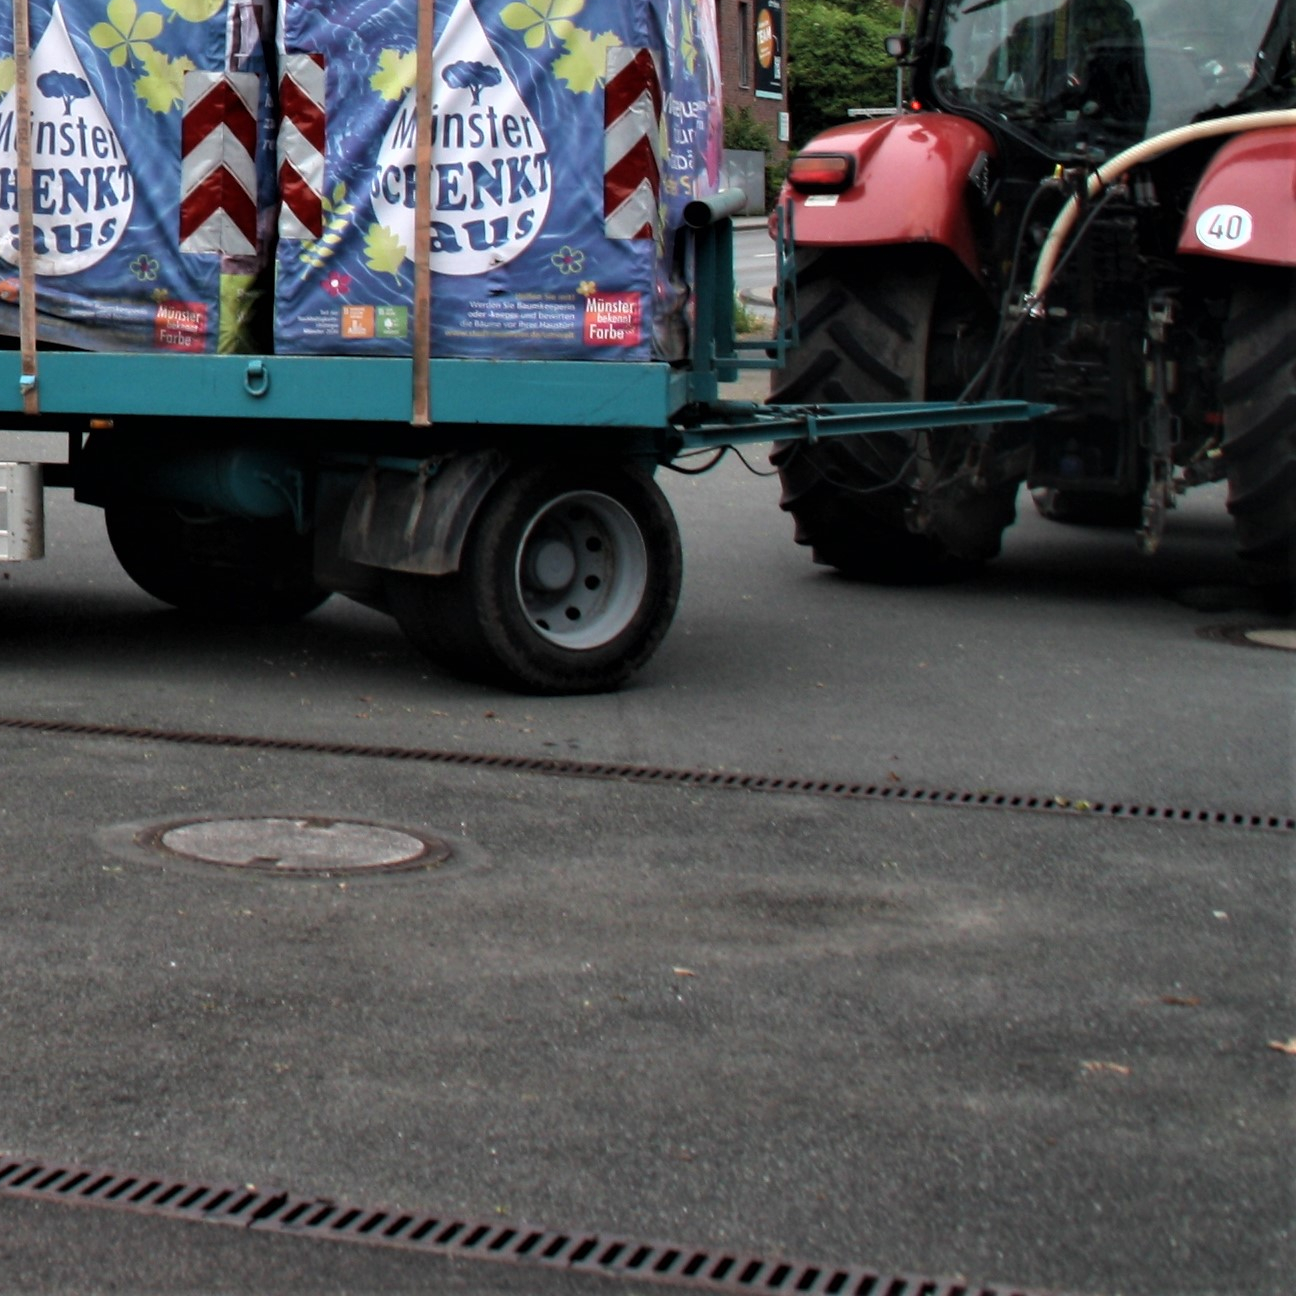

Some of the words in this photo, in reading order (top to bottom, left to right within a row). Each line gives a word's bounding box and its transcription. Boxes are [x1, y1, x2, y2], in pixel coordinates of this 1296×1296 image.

[430, 209, 535, 253] aus
[1208, 213, 1243, 240] 40
[156, 305, 201, 322] Münster
[586, 298, 634, 313] Münster
[596, 312, 631, 324] bekennt
[159, 331, 192, 346] Farbe
[590, 324, 625, 340] Farbe
